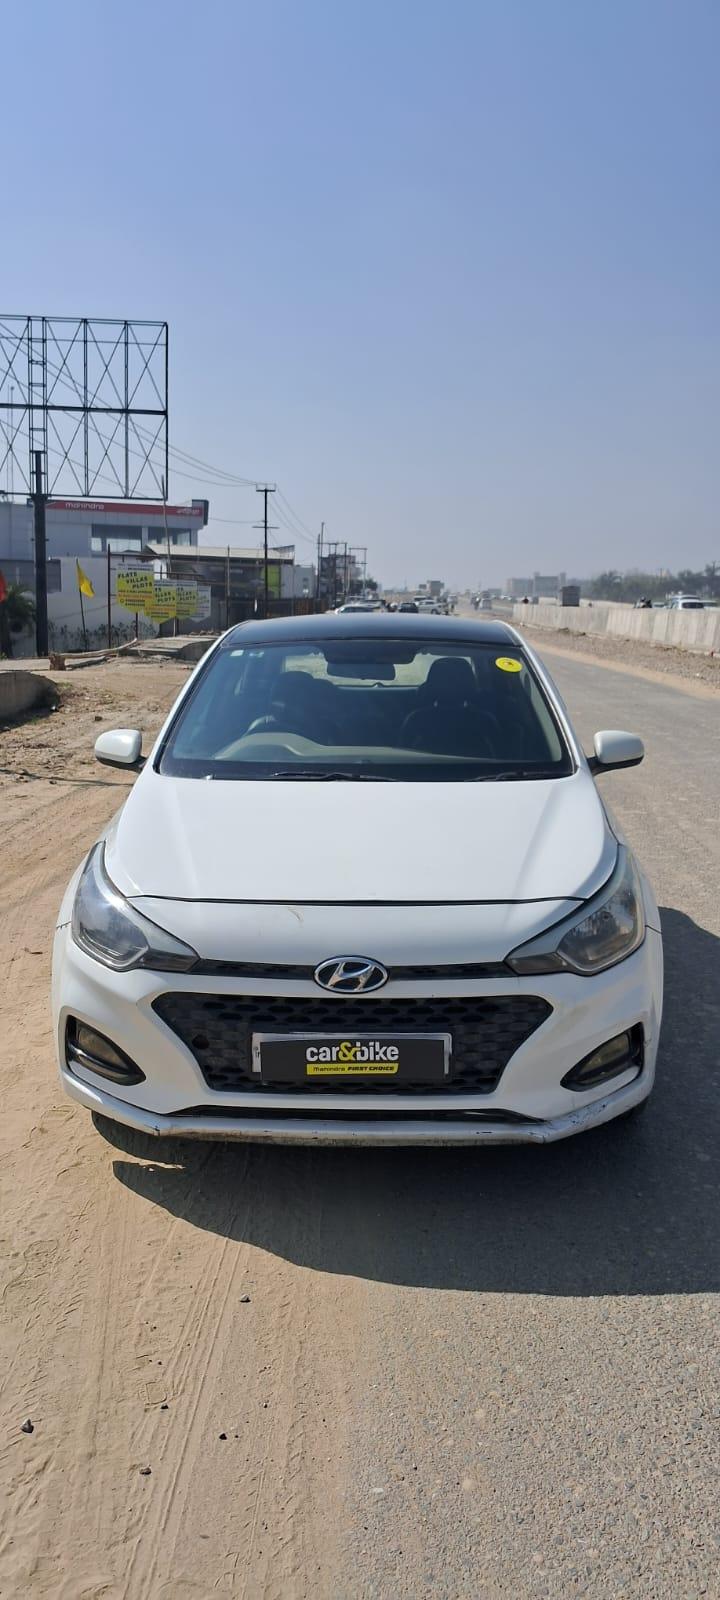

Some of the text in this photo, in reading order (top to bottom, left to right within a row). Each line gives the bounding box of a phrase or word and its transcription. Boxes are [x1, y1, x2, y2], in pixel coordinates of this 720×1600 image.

[65, 502, 105, 510] mahindra
[117, 571, 137, 579] FLATS
[126, 576, 148, 584] VILLAS
[132, 581, 153, 589] PLOTS
